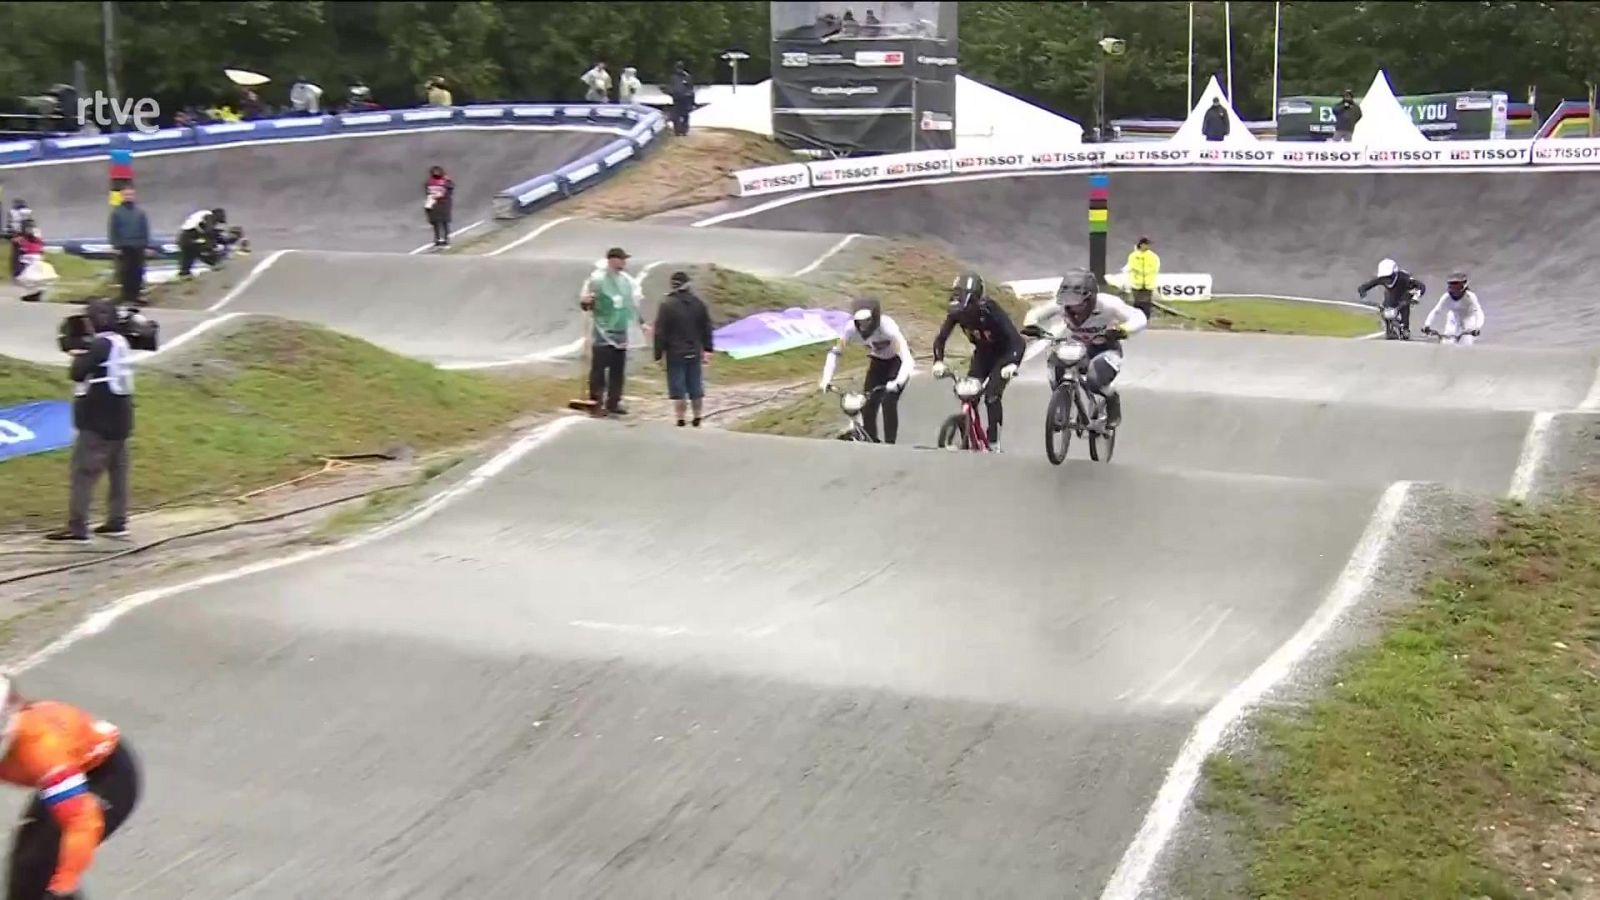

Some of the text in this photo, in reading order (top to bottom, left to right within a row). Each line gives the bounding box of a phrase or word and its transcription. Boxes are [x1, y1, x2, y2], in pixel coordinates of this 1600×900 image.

[1417, 103, 1447, 120] YOU
[1055, 151, 1106, 162] TISSOT
[1138, 150, 1190, 160] TISSOT
[1222, 150, 1275, 161] TISSOT
[1306, 151, 1360, 162] TISSOT
[1391, 150, 1441, 161] TISSOT
[1474, 149, 1527, 160] TISSOT
[1554, 147, 1600, 158] TISSOT
[978, 154, 1024, 166] TISSOT
[905, 160, 948, 174] TISSOT
[834, 166, 879, 180] TISSOT
[762, 173, 804, 188] TISSOT
[1157, 284, 1206, 296] ISSOT
